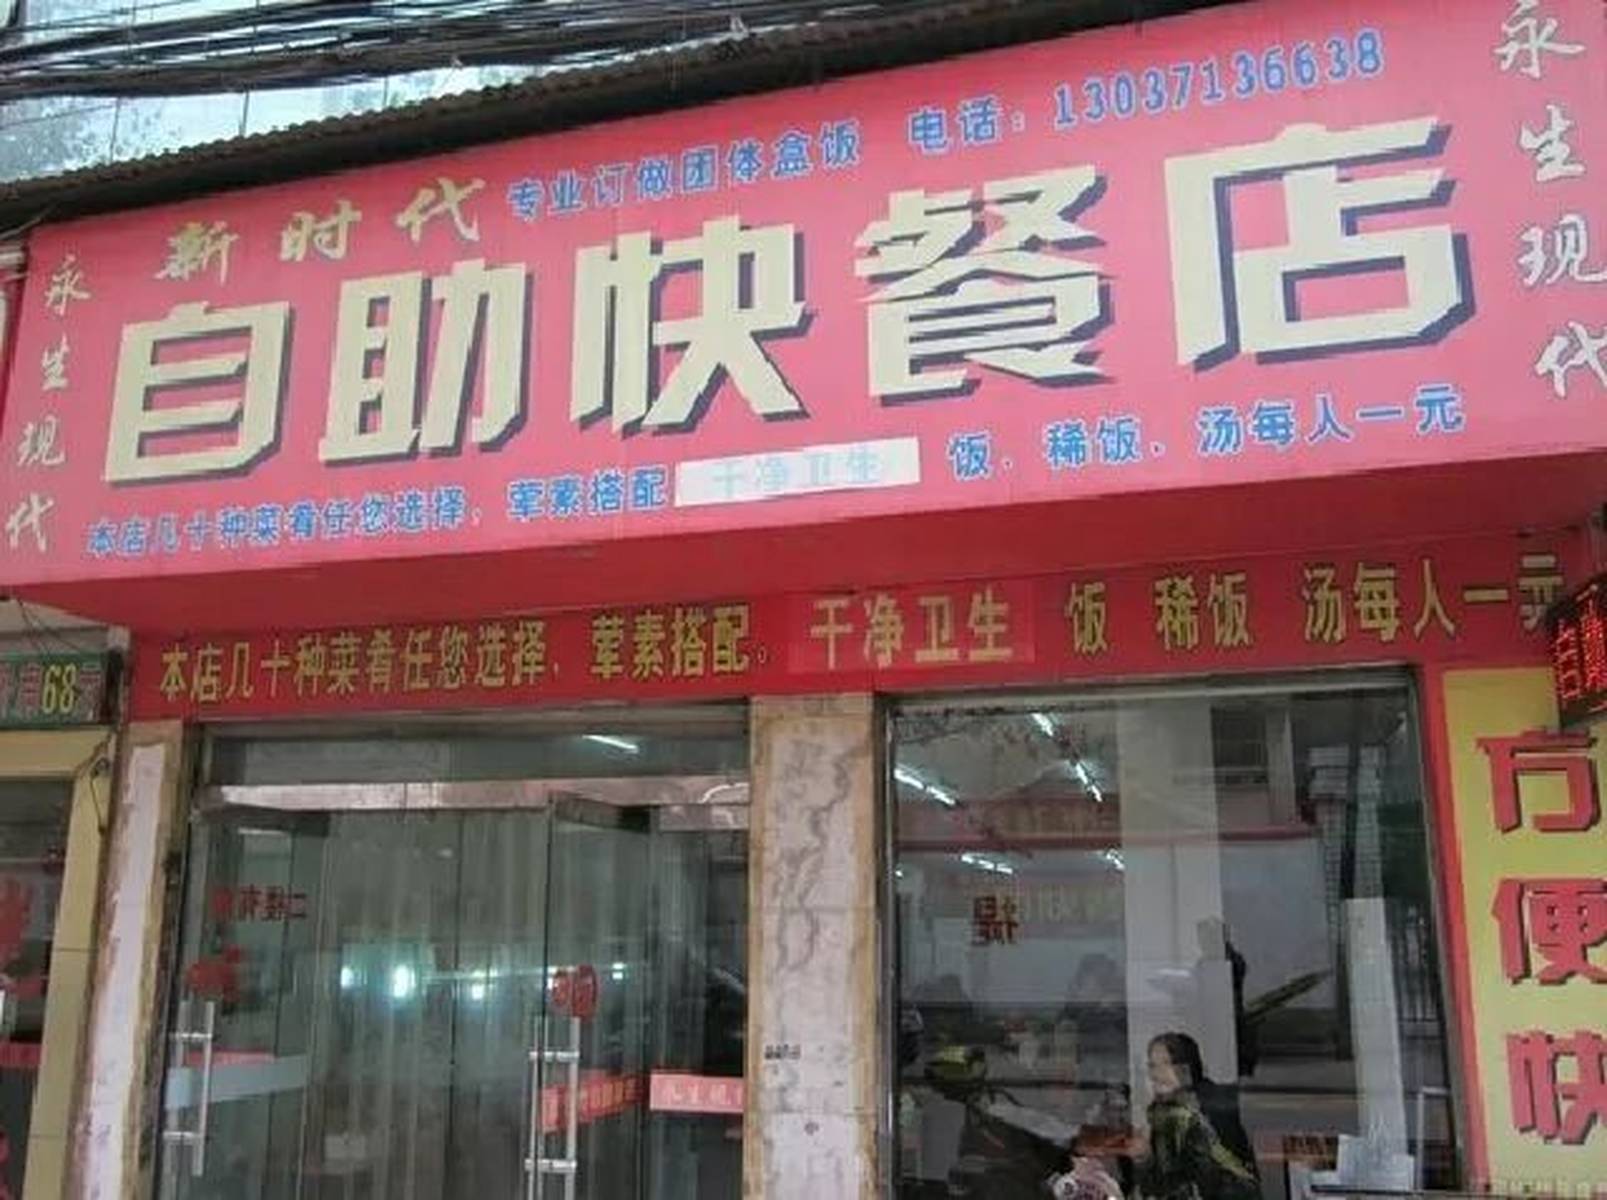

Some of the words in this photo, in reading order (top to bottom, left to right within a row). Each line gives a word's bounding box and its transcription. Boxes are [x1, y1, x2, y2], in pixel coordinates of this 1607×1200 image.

[507, 118, 861, 222] 专业订做团体盒饭
[1494, 0, 1607, 398] 永生现代
[153, 176, 486, 286] 新时代
[103, 115, 1475, 485] 自助快餐店
[3, 253, 92, 554] 永生现代
[1197, 385, 1465, 456] 汤每人一元
[507, 465, 668, 521] 荤素搭配
[709, 447, 883, 500] 干净卫生
[809, 584, 1014, 670] 干净卫生
[1154, 573, 1251, 651] 稀饭
